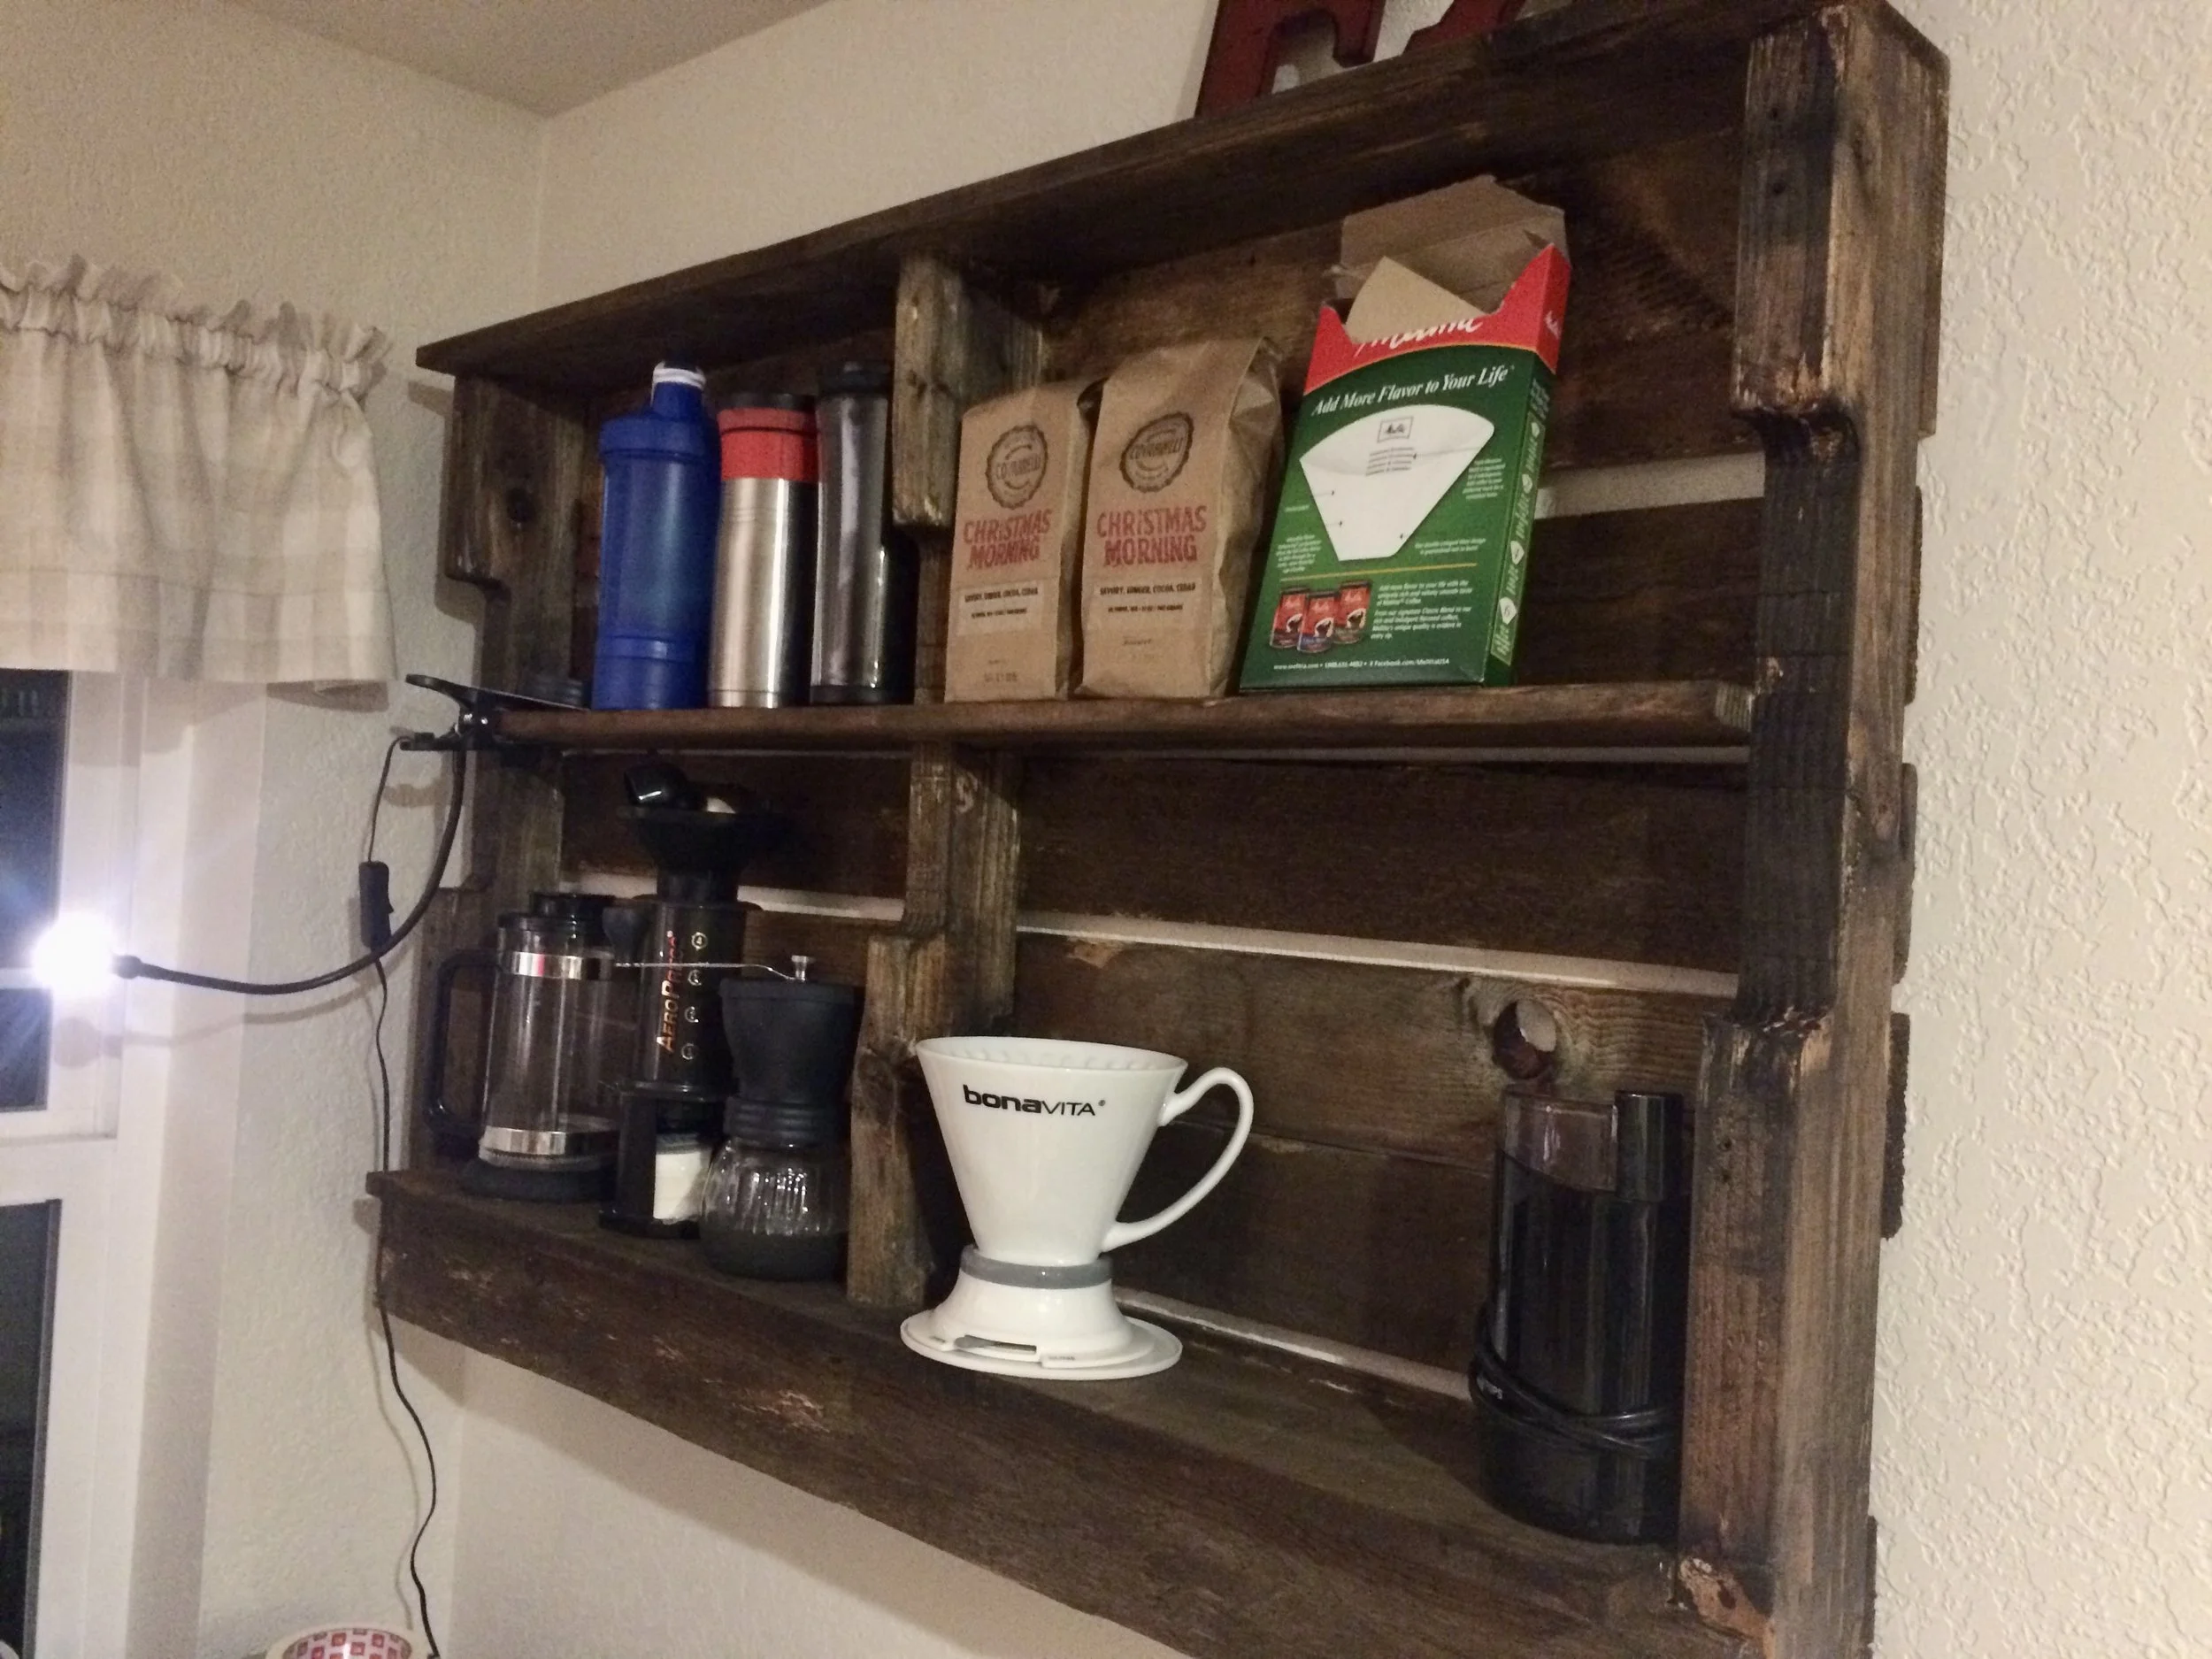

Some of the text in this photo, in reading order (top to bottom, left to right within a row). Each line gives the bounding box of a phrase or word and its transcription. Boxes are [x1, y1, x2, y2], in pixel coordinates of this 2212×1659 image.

[1311, 365, 1509, 416] Add More Flavor to Your Life
[964, 510, 1052, 544] CHRISTMAS
[1097, 505, 1207, 538] CHRISTMAS
[968, 534, 1041, 571] MORNING
[1104, 534, 1197, 567] MORNING
